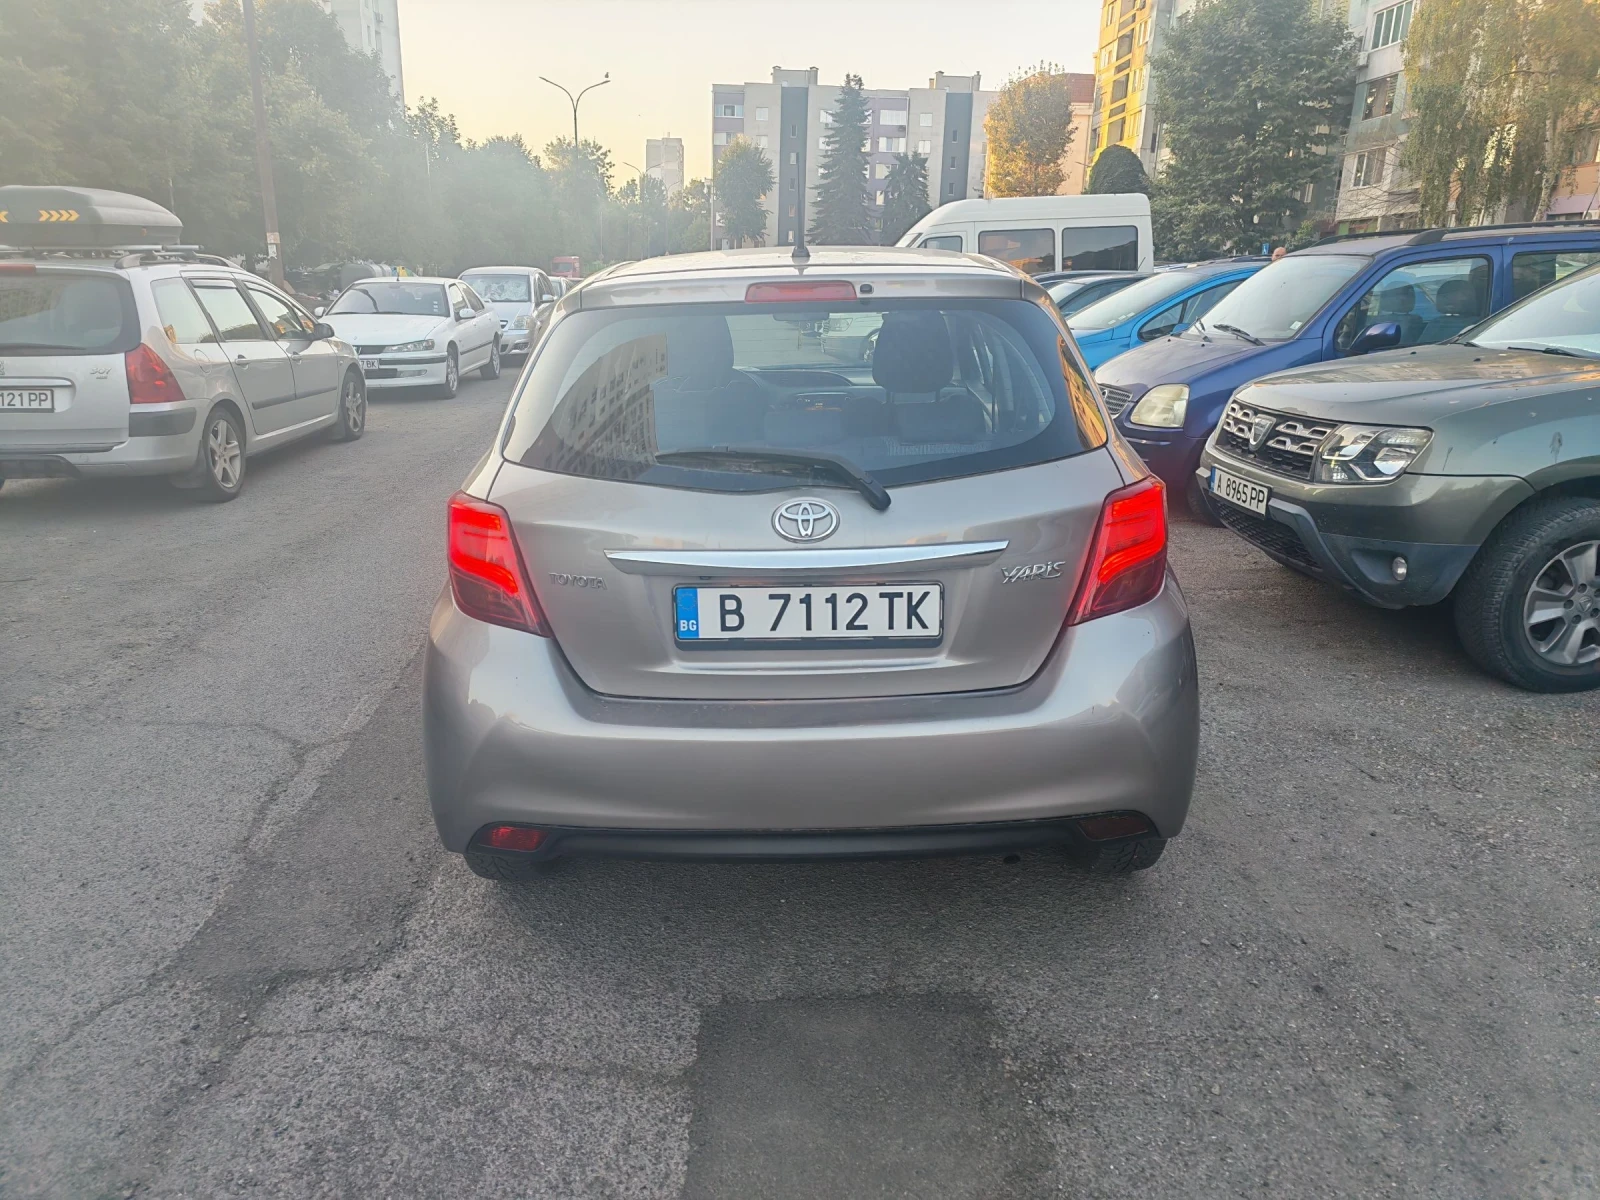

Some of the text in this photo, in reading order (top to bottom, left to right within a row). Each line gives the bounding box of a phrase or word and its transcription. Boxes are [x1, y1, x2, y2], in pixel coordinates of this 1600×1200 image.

[28, 392, 48, 407] PP
[1217, 474, 1265, 509] A 8965 PP
[548, 572, 608, 590] TOYOTA
[719, 591, 931, 632] B 7112 TK
[680, 620, 697, 631] BG
